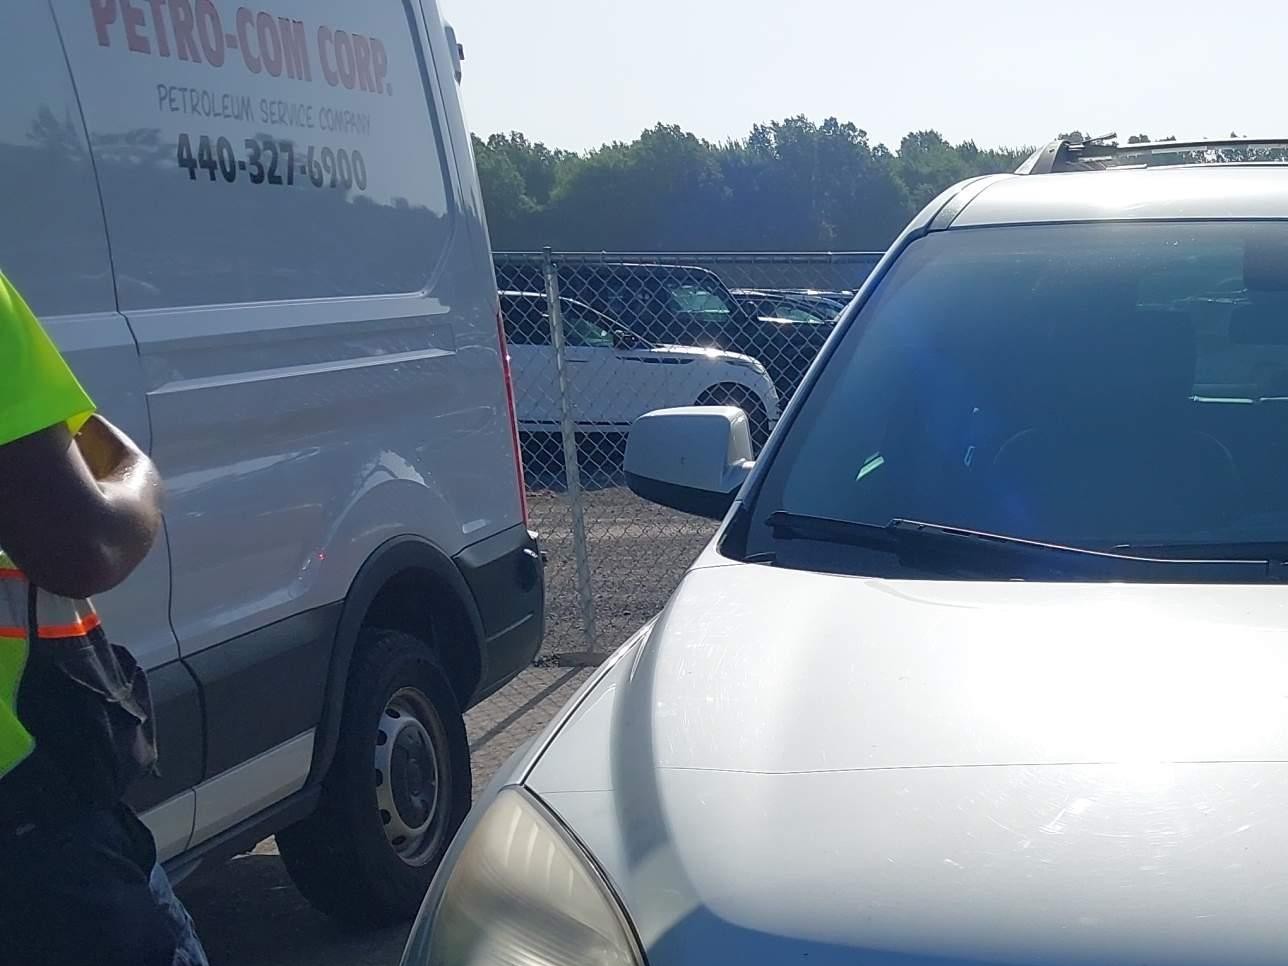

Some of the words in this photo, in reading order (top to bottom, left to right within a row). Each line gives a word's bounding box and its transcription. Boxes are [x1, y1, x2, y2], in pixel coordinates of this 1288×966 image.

[90, 0, 312, 82] PETRO-COM
[317, 25, 393, 96] CORP.
[157, 84, 254, 122] PETROLEUM
[259, 99, 315, 129] SERVICE
[319, 106, 371, 137] COMPANY
[176, 133, 368, 191] 440-327-6900
